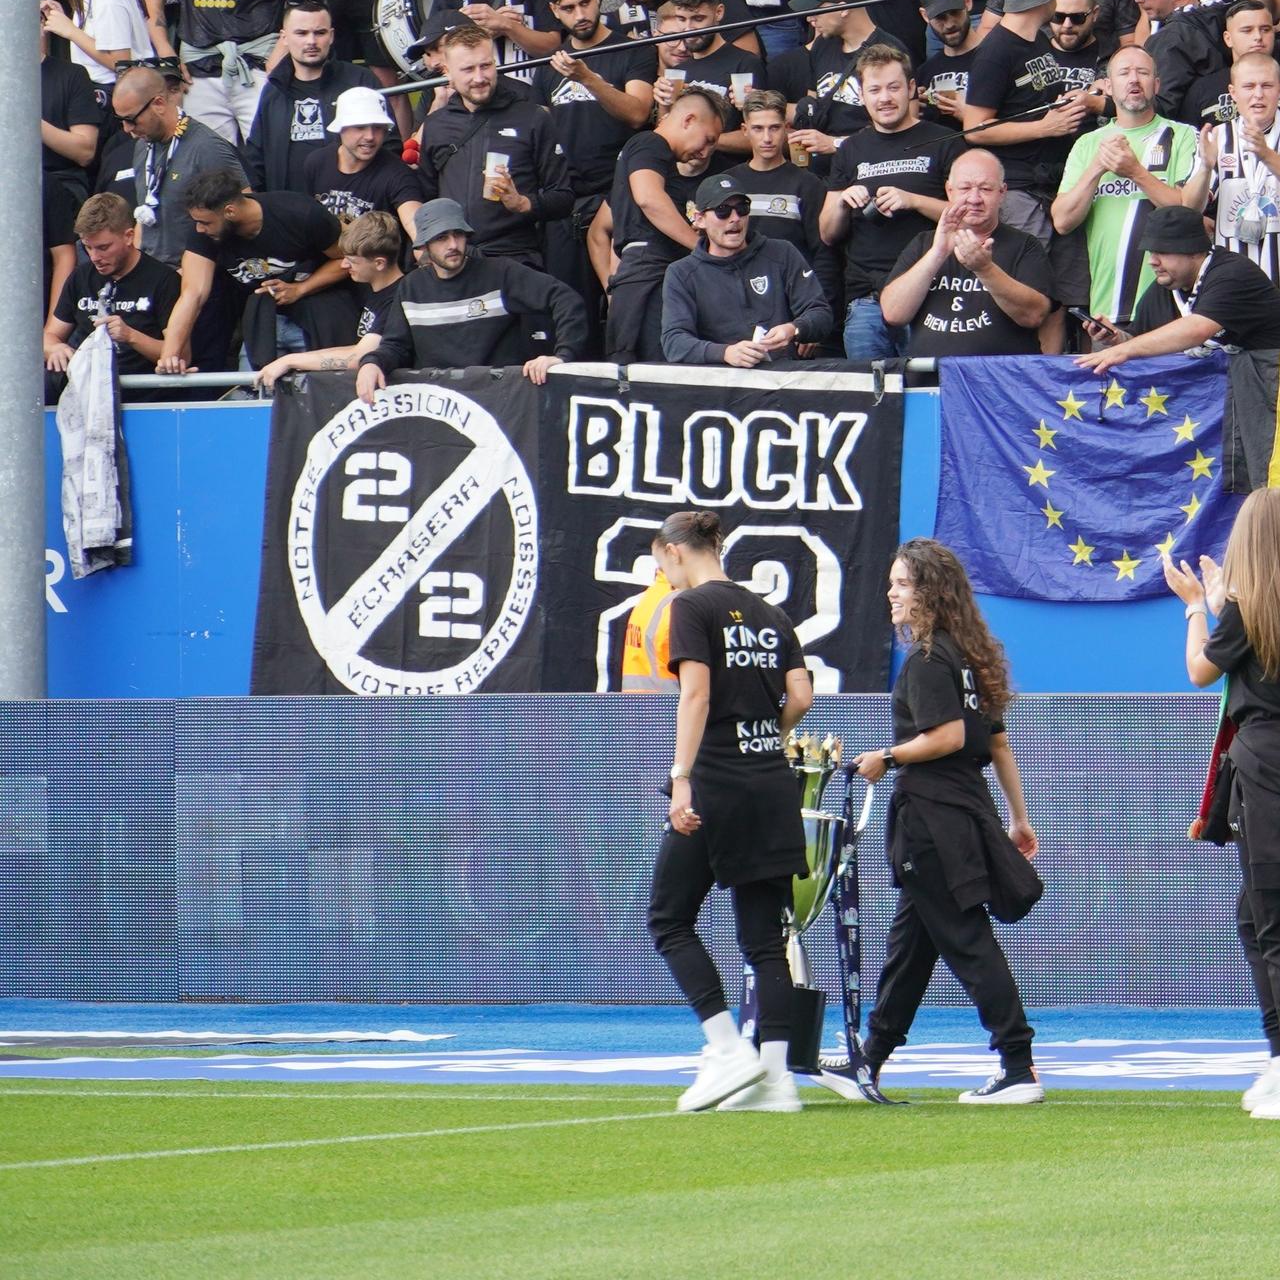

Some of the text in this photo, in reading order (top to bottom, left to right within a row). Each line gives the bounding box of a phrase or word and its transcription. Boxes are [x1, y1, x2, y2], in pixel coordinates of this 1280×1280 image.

[924, 310, 993, 334] BIEN ÉLEVÉ
[950, 298, 963, 312] &
[327, 391, 471, 449] PASSION
[567, 394, 868, 511] BLOCK
[341, 450, 412, 523] 2
[418, 570, 485, 640] 2
[721, 625, 779, 650] KING
[725, 651, 779, 670] POWER
